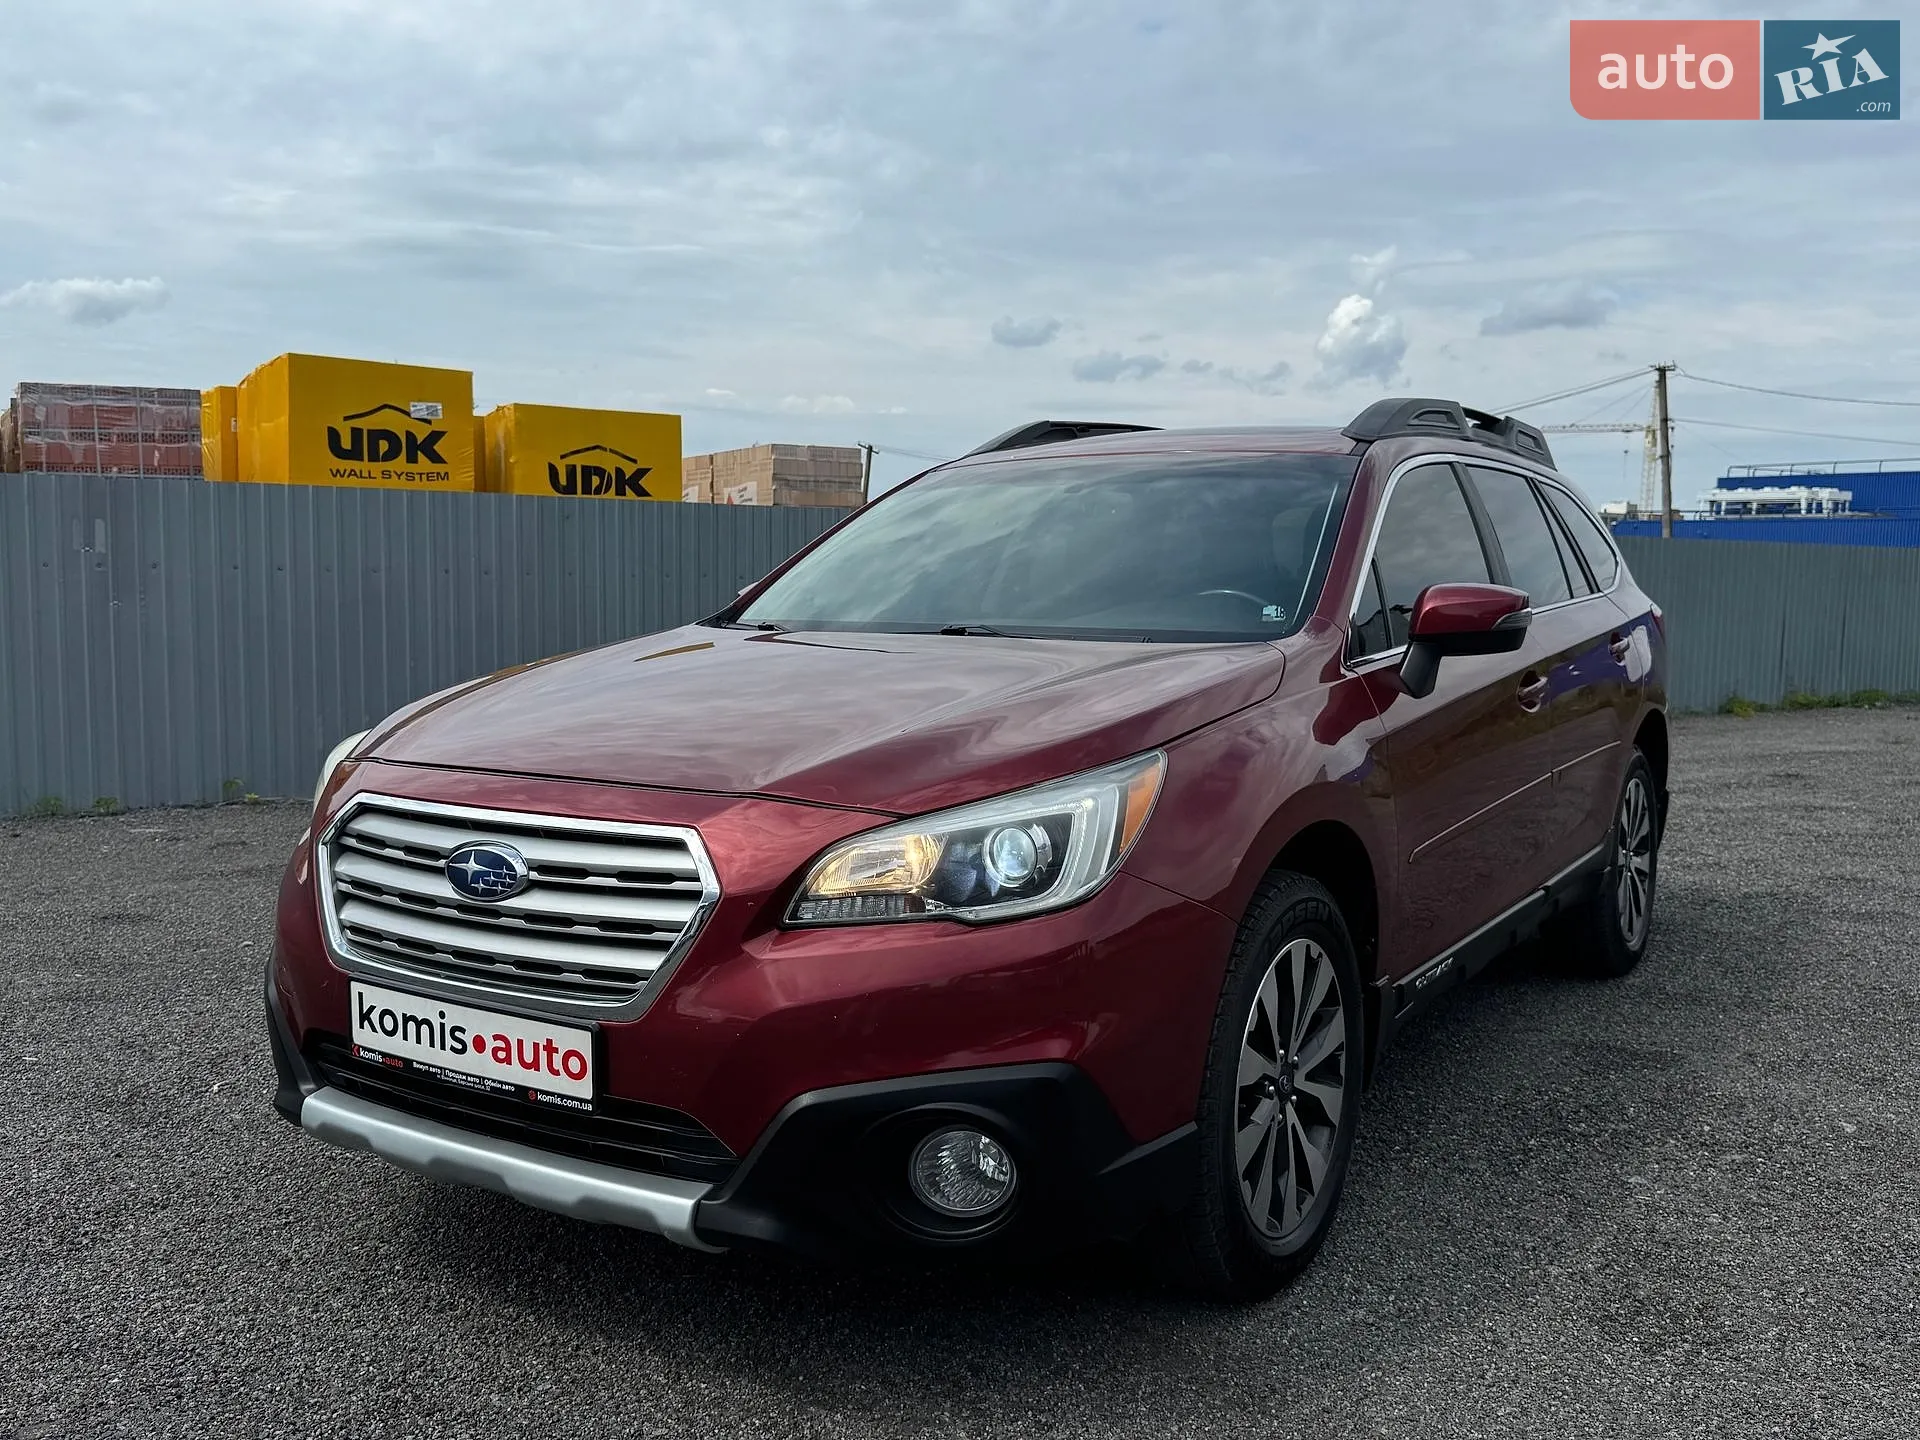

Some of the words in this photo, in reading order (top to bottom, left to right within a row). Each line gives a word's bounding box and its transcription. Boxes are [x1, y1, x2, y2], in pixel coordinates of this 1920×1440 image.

[327, 426, 449, 465] UDK
[329, 467, 377, 480] WALL
[381, 470, 450, 482] SYSTEM
[547, 461, 653, 497] UDK
[537, 1091, 593, 1111] komis.com.ua
